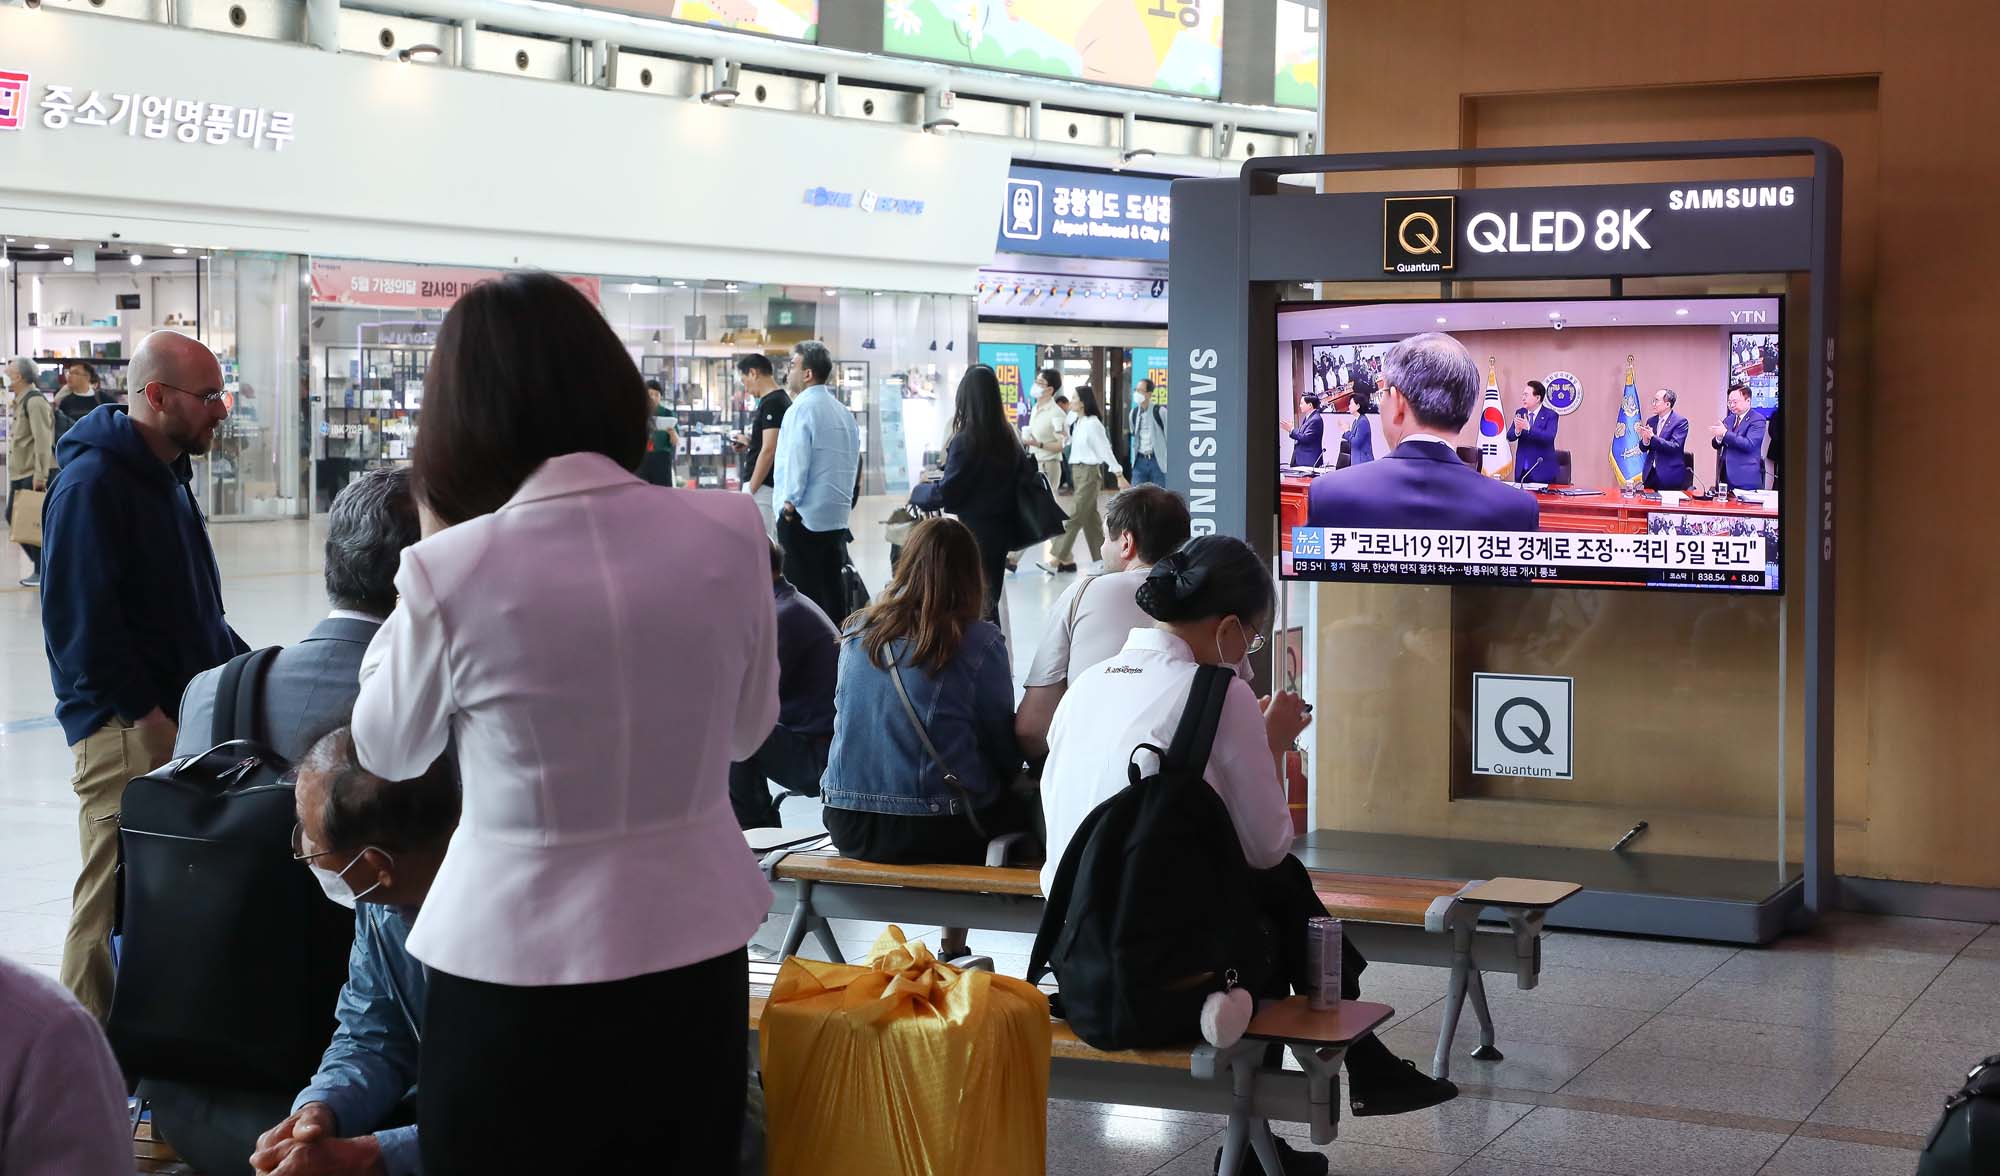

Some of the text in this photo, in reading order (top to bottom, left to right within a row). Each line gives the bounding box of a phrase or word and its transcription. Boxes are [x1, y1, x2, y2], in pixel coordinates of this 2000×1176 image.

[40, 84, 295, 151] 중소기업명품마루
[1052, 187, 1120, 219] 공항철도
[1669, 186, 1795, 210] SAMSUNG
[1398, 211, 1442, 255] Q
[1466, 208, 1655, 254] QLED 8K
[1397, 263, 1440, 274] Quantum
[351, 277, 369, 292] 5월
[373, 278, 417, 295] 가정의달
[421, 281, 458, 298] 감사의
[1730, 310, 1766, 323] YTN
[1188, 348, 1218, 538] SAMSUNG
[1823, 337, 1835, 561] SAMSUNG
[1296, 531, 1320, 544] 뉴스
[1329, 533, 1347, 555] 尹
[1351, 531, 1432, 558] "코로나19
[1437, 535, 1471, 559] 위기
[1477, 537, 1512, 560] 경보
[1518, 537, 1571, 561] 경계로
[1675, 541, 1705, 565] 5일
[1712, 540, 1756, 566] 권고"
[1295, 545, 1321, 555] LIVE
[1330, 562, 1346, 572] 정치
[1351, 562, 1371, 574] 정부,
[1372, 562, 1398, 574] 한상혁
[1419, 563, 1436, 575] 절차
[1500, 565, 1518, 577] 청문
[1520, 566, 1537, 578] 개시
[1539, 567, 1558, 578] 통보
[1697, 572, 1726, 582] 838.54
[1741, 574, 1760, 583] 8.80
[1494, 696, 1554, 755] Q
[1493, 763, 1552, 777] Quantum
